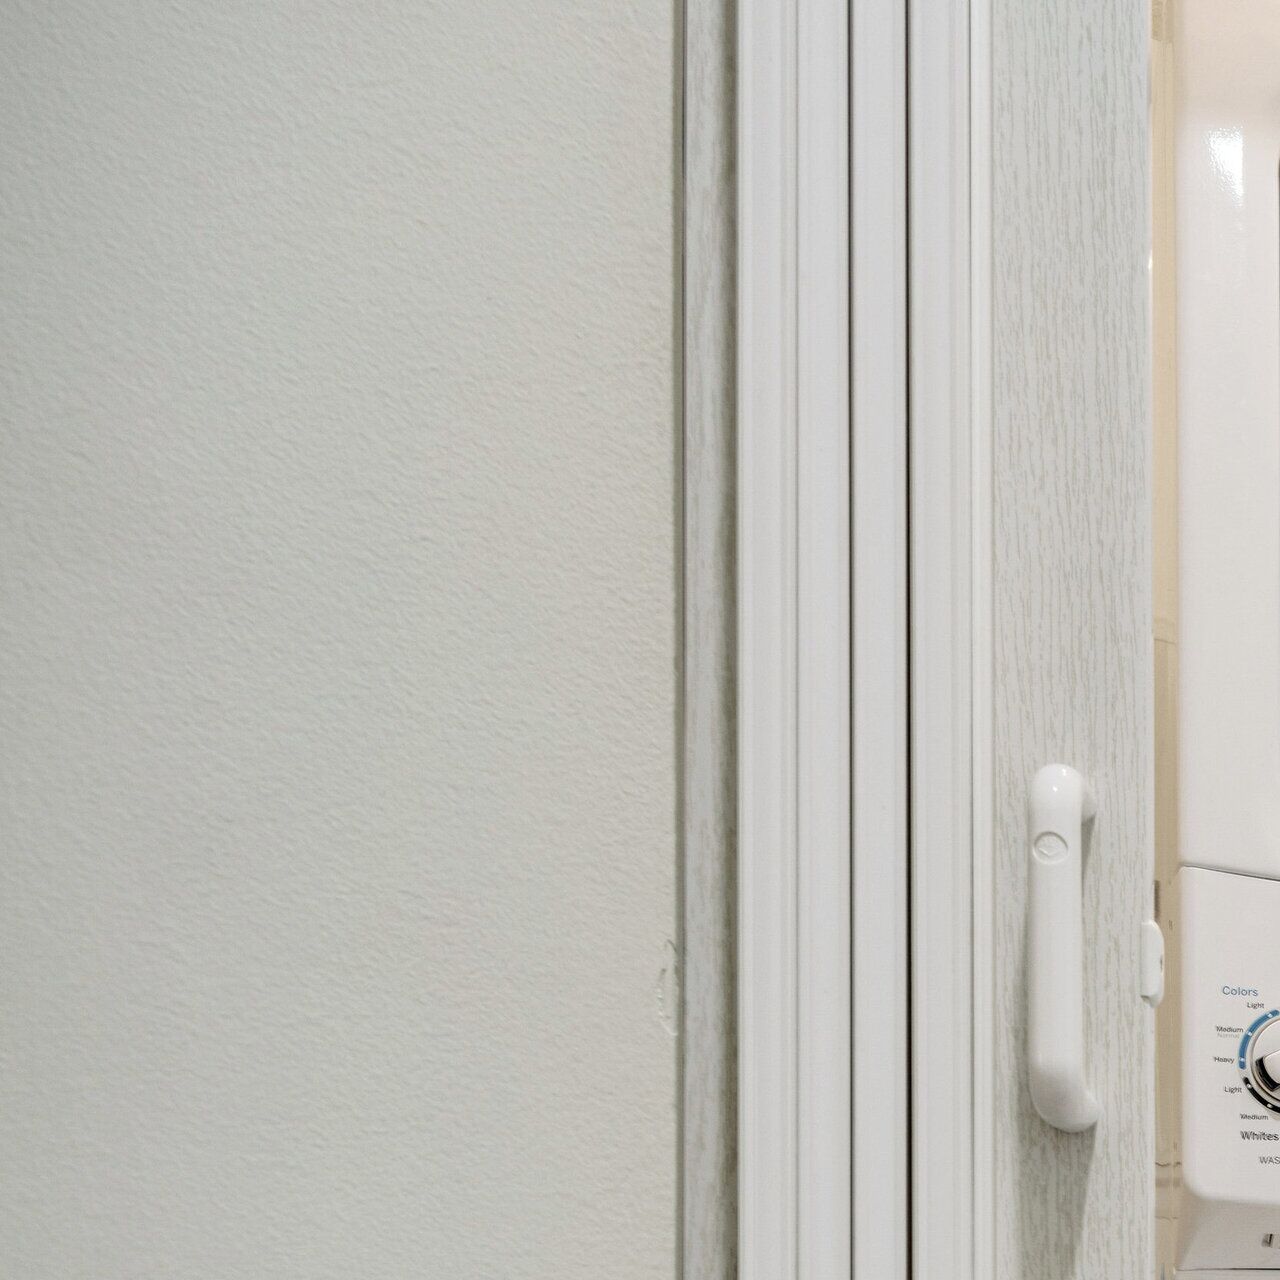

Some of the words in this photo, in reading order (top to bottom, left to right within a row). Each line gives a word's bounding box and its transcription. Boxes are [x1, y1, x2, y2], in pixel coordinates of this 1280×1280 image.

[1222, 985, 1259, 997] Colors
[1246, 1002, 1265, 1010] Light
[1214, 1056, 1235, 1064] Heavy
[1224, 1086, 1242, 1094] Light
[1240, 1113, 1269, 1121] Medium
[1240, 1130, 1280, 1141] Whites
